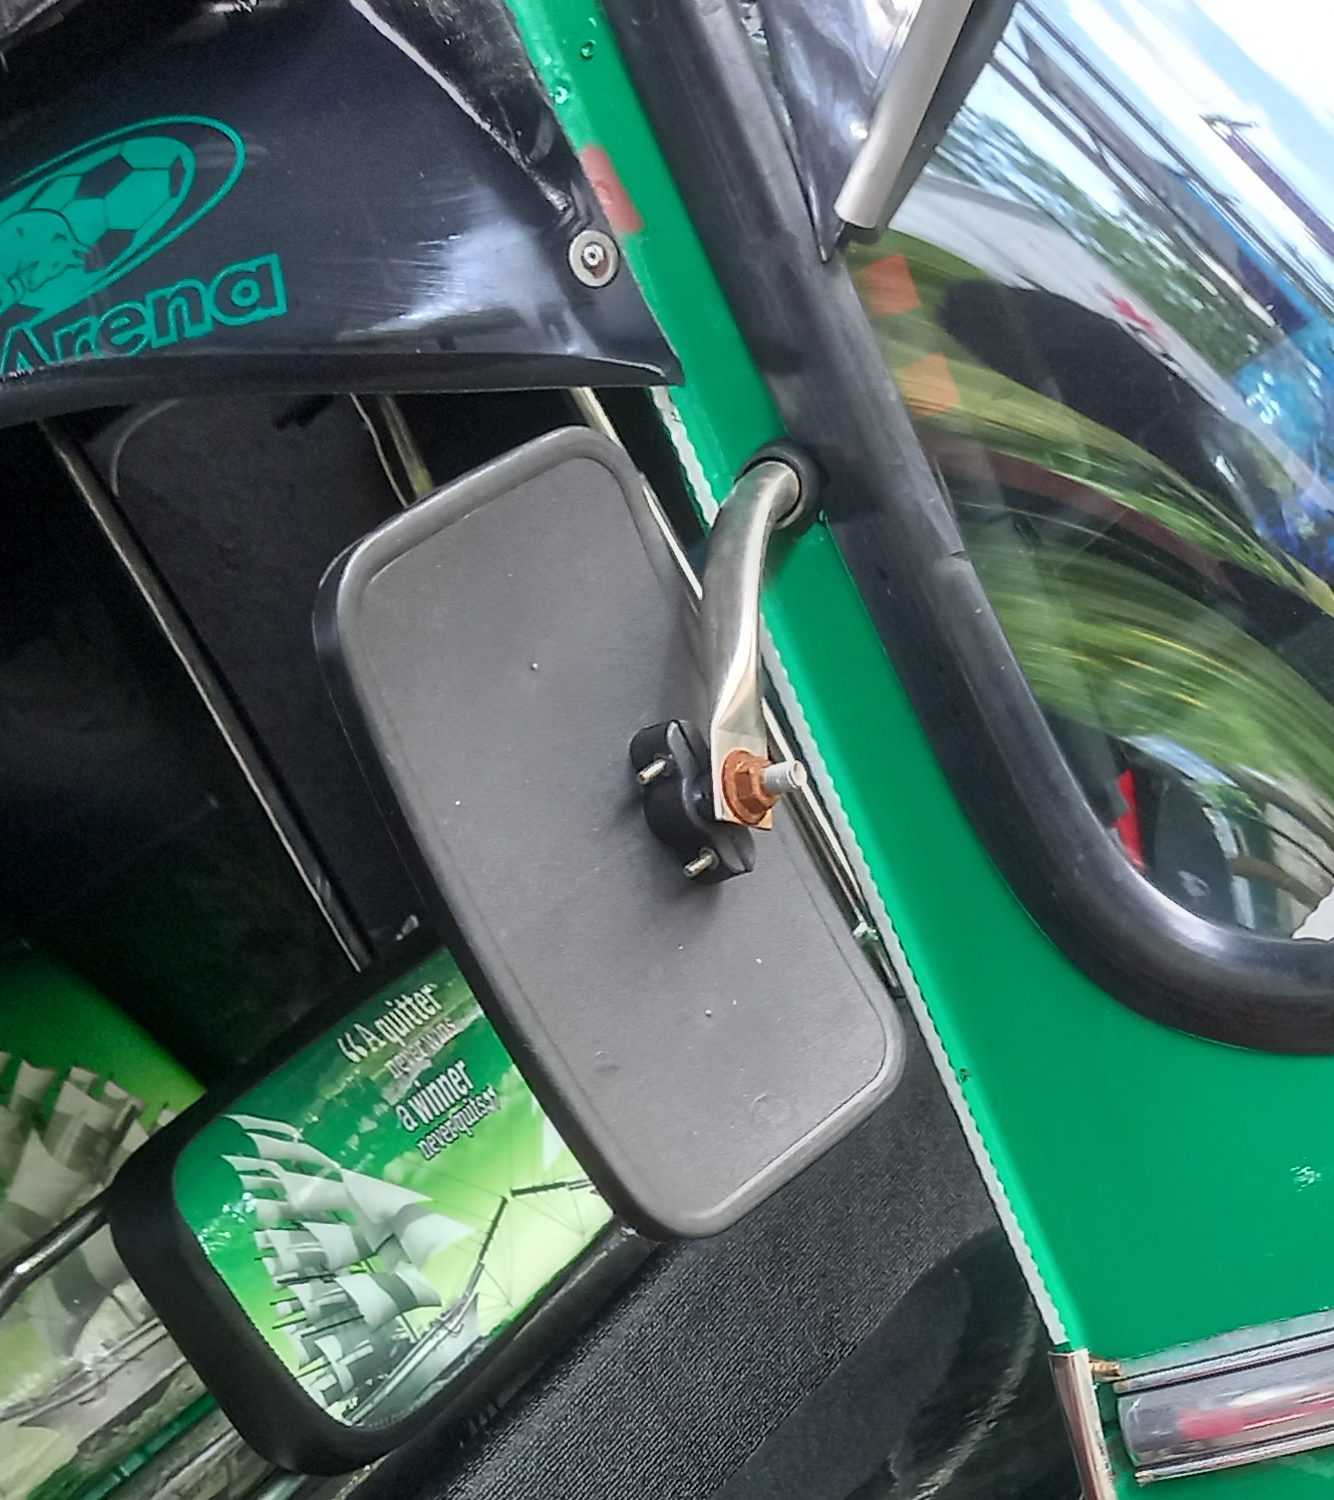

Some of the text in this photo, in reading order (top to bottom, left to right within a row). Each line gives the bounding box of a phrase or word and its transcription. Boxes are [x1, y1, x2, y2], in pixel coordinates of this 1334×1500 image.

[376, 983, 443, 1047] quitter
[396, 1058, 475, 1132] a winner
[416, 1124, 459, 1161] never
